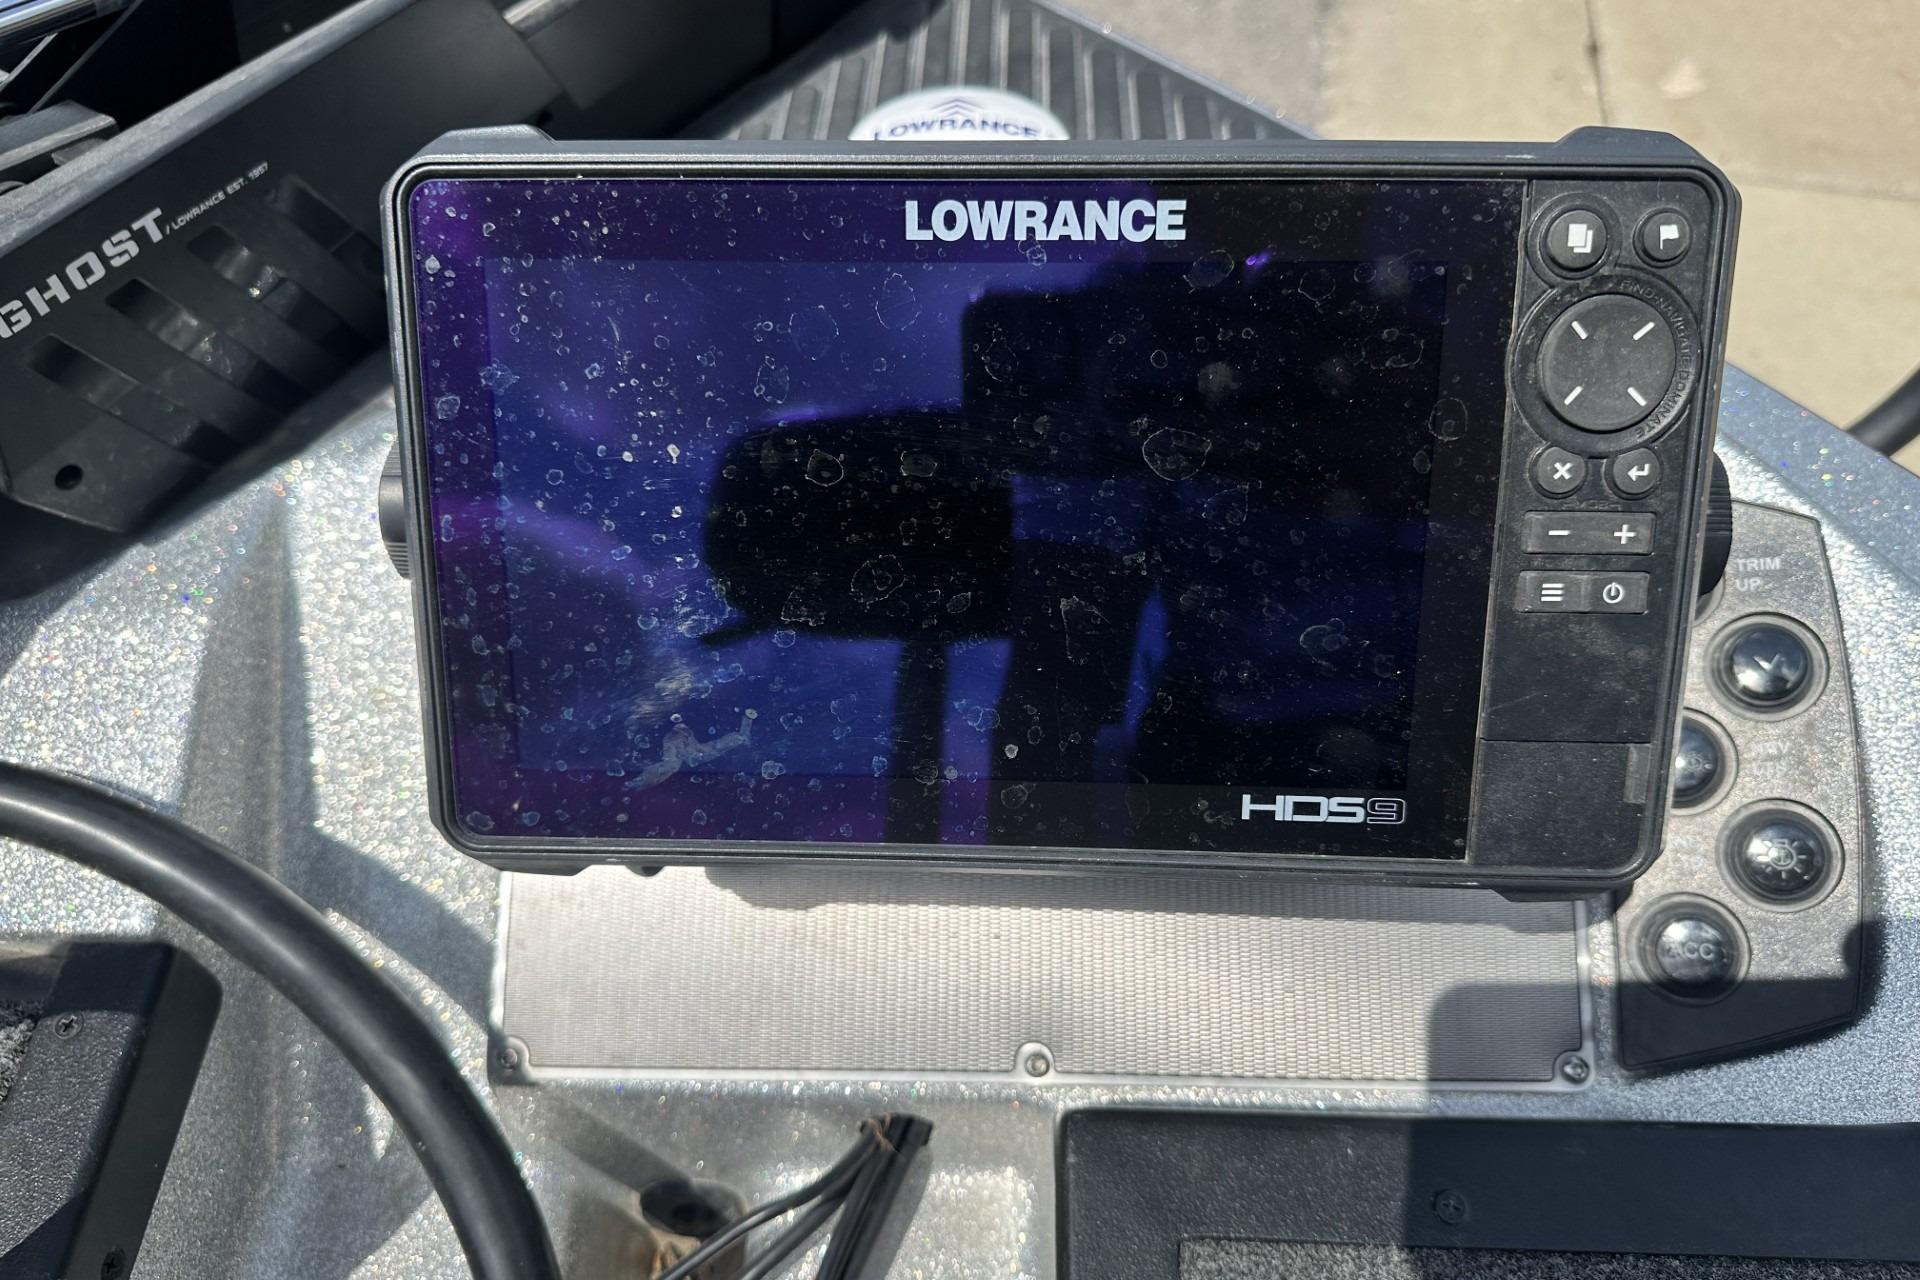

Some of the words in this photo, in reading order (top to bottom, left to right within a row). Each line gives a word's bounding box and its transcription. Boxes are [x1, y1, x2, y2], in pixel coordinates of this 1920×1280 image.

[872, 117, 1040, 141] LOWRANCE
[904, 199, 1188, 243] LOWRANCE
[0, 207, 162, 339] GHOST
[1736, 556, 1781, 572] TRIM
[1735, 576, 1761, 592] UP
